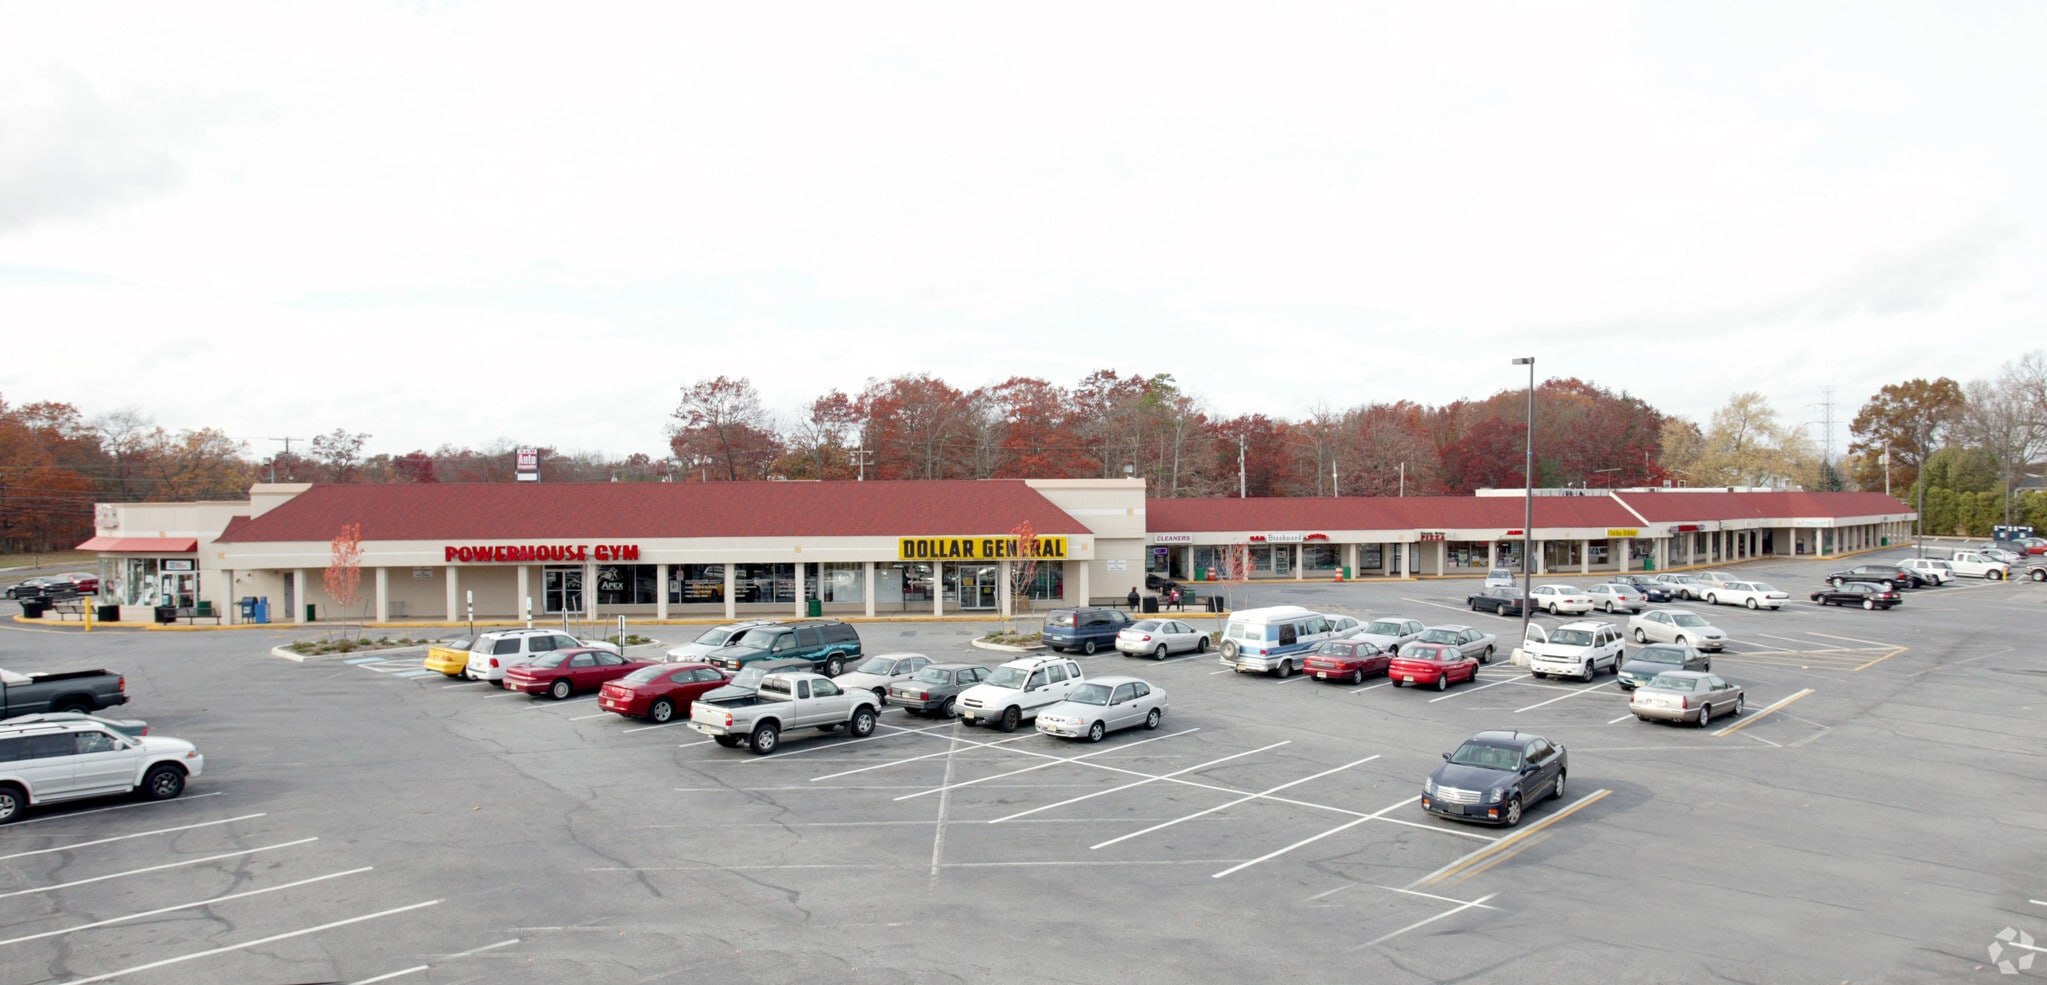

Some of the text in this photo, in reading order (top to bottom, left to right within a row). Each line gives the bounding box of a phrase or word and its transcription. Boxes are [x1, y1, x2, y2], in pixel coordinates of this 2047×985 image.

[517, 453, 537, 466] Auto
[445, 544, 639, 562] POWERHOUSE GYM
[903, 539, 975, 558] DOLLAR
[601, 580, 624, 591] APEX
